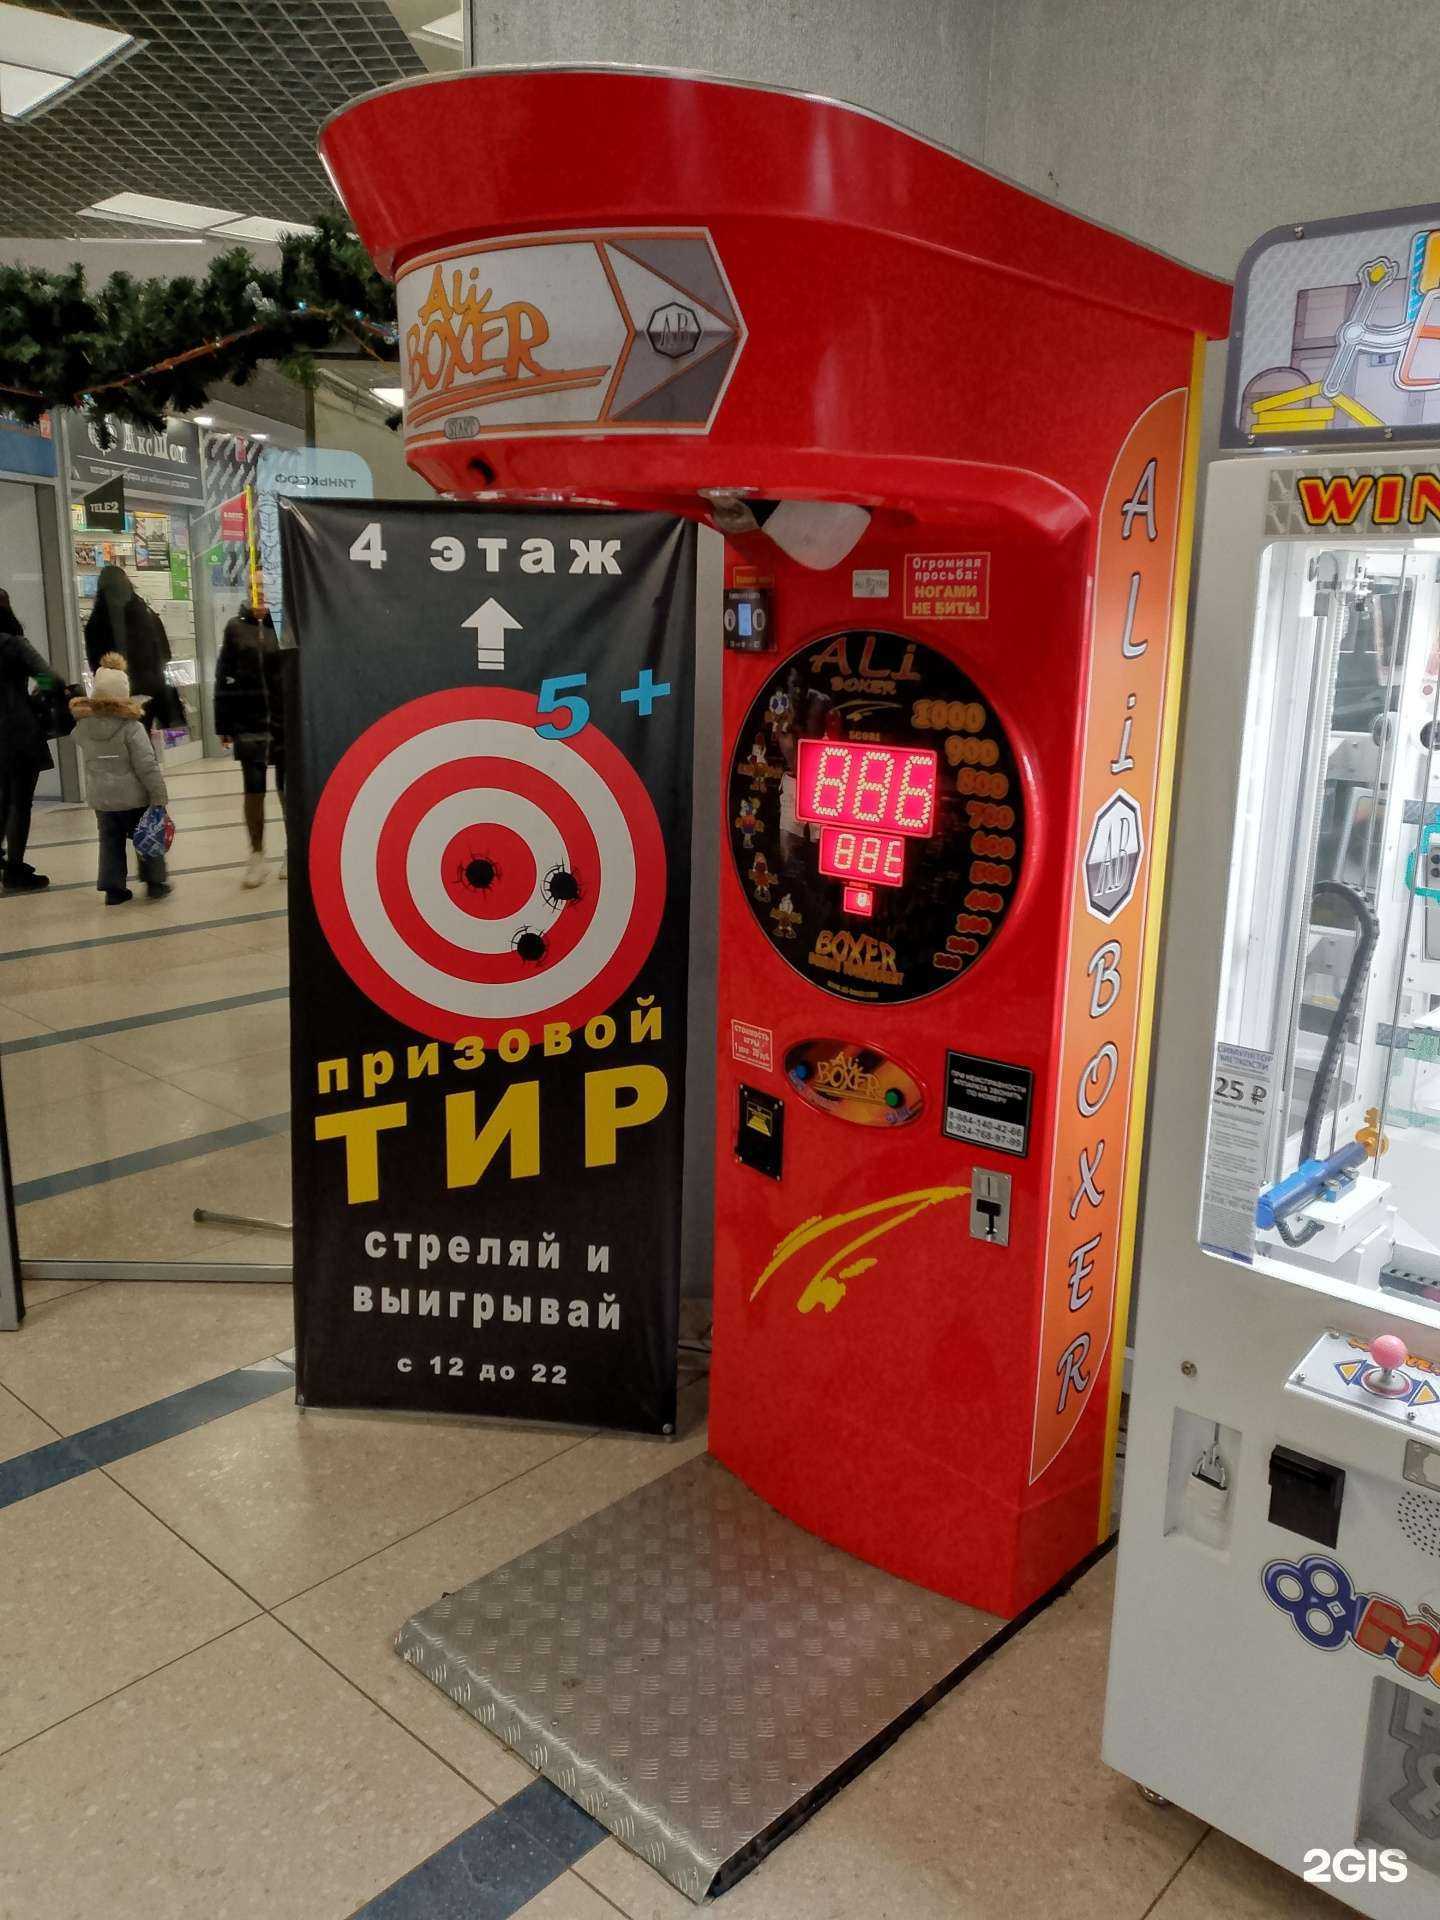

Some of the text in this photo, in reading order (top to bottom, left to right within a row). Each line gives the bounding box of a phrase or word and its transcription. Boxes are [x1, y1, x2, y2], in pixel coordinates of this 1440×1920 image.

[406, 301, 550, 398] BOXER
[90, 501, 119, 513] TELE2
[348, 522, 622, 575] 4 этаж
[912, 557, 982, 571] Огромная
[914, 570, 979, 582] просьба:
[914, 585, 978, 599] НОГАМИ
[911, 602, 980, 616] НЕ БИТЬ!
[911, 699, 986, 733] 1000
[814, 930, 898, 974] BOXER
[317, 995, 663, 1098] призовой
[1214, 1076, 1244, 1101] 25
[315, 1064, 669, 1205] ТИР
[1055, 939, 1122, 1414] BOXER
[364, 1231, 610, 1274] стреляй и
[353, 1285, 621, 1330] выигрывай
[397, 1356, 567, 1385] с 12 до 22
